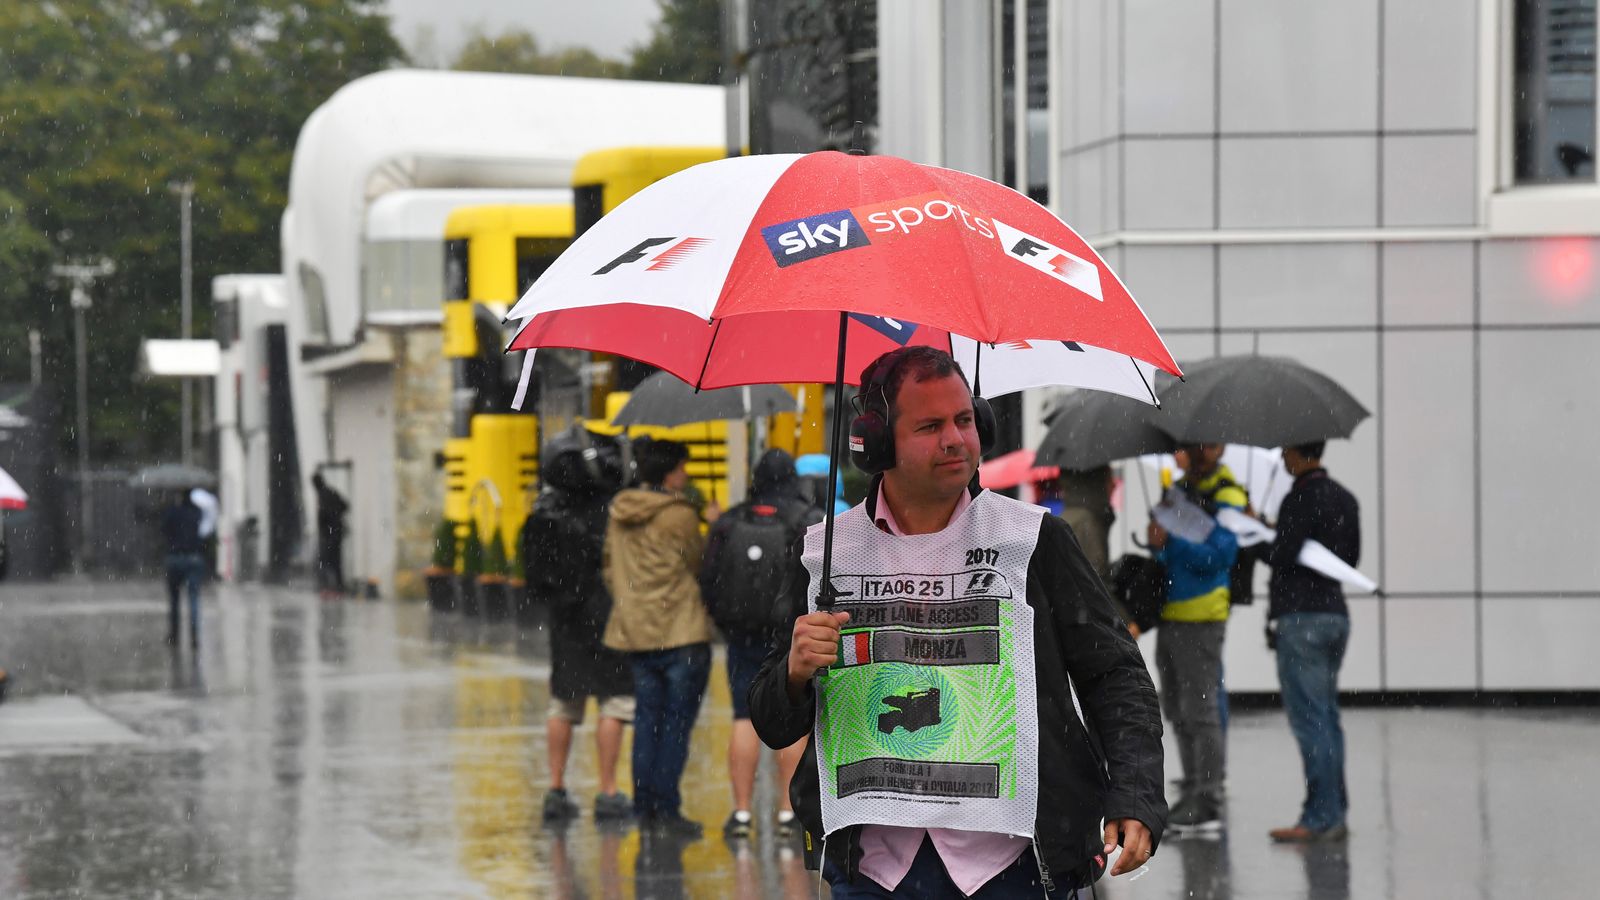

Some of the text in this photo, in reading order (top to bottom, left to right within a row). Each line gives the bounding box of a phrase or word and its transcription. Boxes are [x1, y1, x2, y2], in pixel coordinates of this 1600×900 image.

[778, 218, 850, 255] sky
[868, 199, 996, 239] sports
[591, 237, 716, 276] F1
[965, 547, 999, 567] 2017
[865, 580, 944, 597] ITA06 25
[867, 607, 887, 624] PIT
[892, 607, 924, 624] LANE
[928, 606, 979, 624] ACCESS
[905, 636, 967, 660] MONZA
[884, 762, 924, 777] FORMULA
[969, 782, 993, 794] 2017
